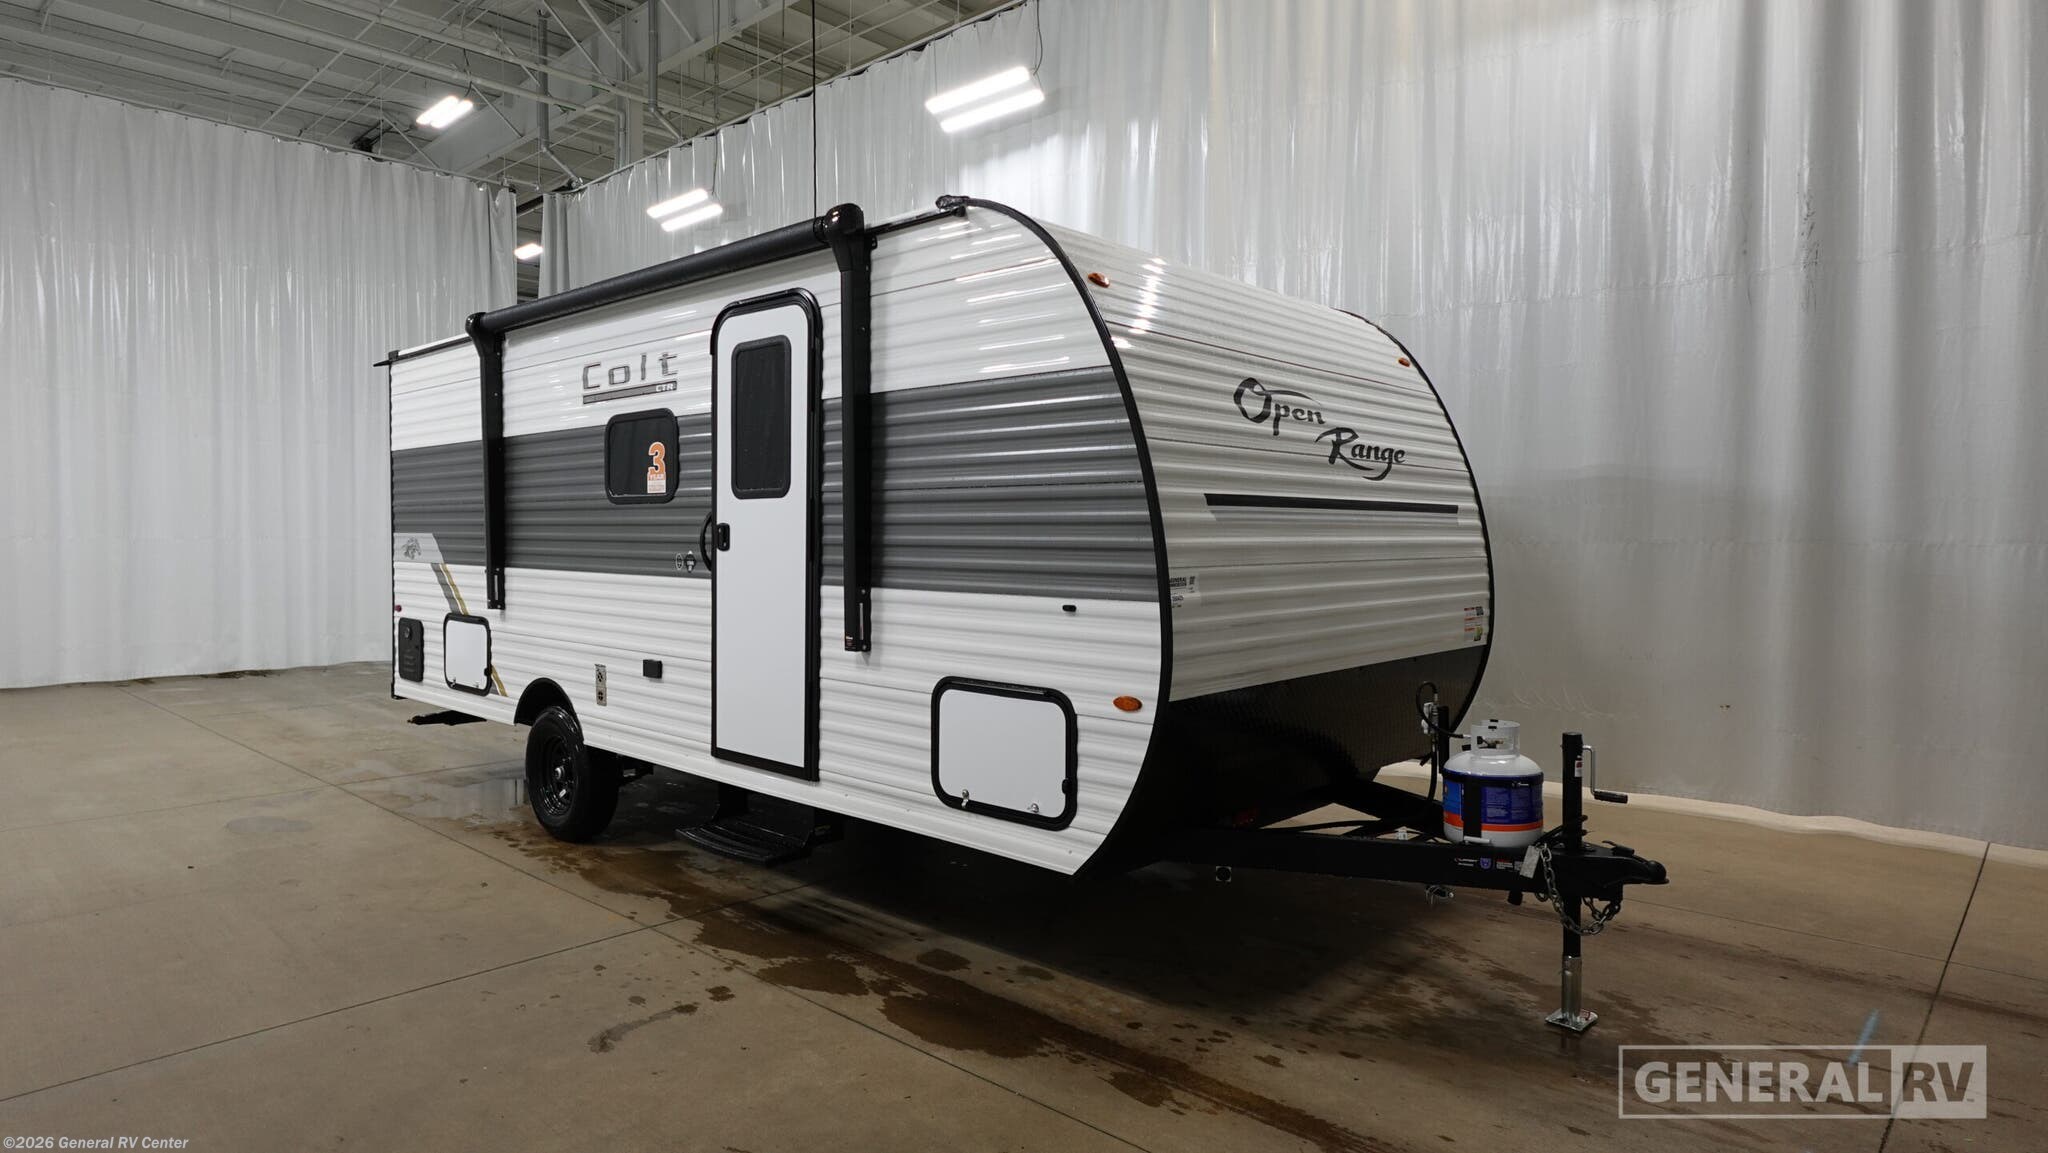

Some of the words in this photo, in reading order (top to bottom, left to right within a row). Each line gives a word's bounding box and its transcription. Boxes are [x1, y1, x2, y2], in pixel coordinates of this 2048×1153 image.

[583, 353, 678, 389] Colt
[1233, 377, 1326, 436] Open
[649, 442, 666, 474] 3
[1315, 427, 1406, 481] Range
